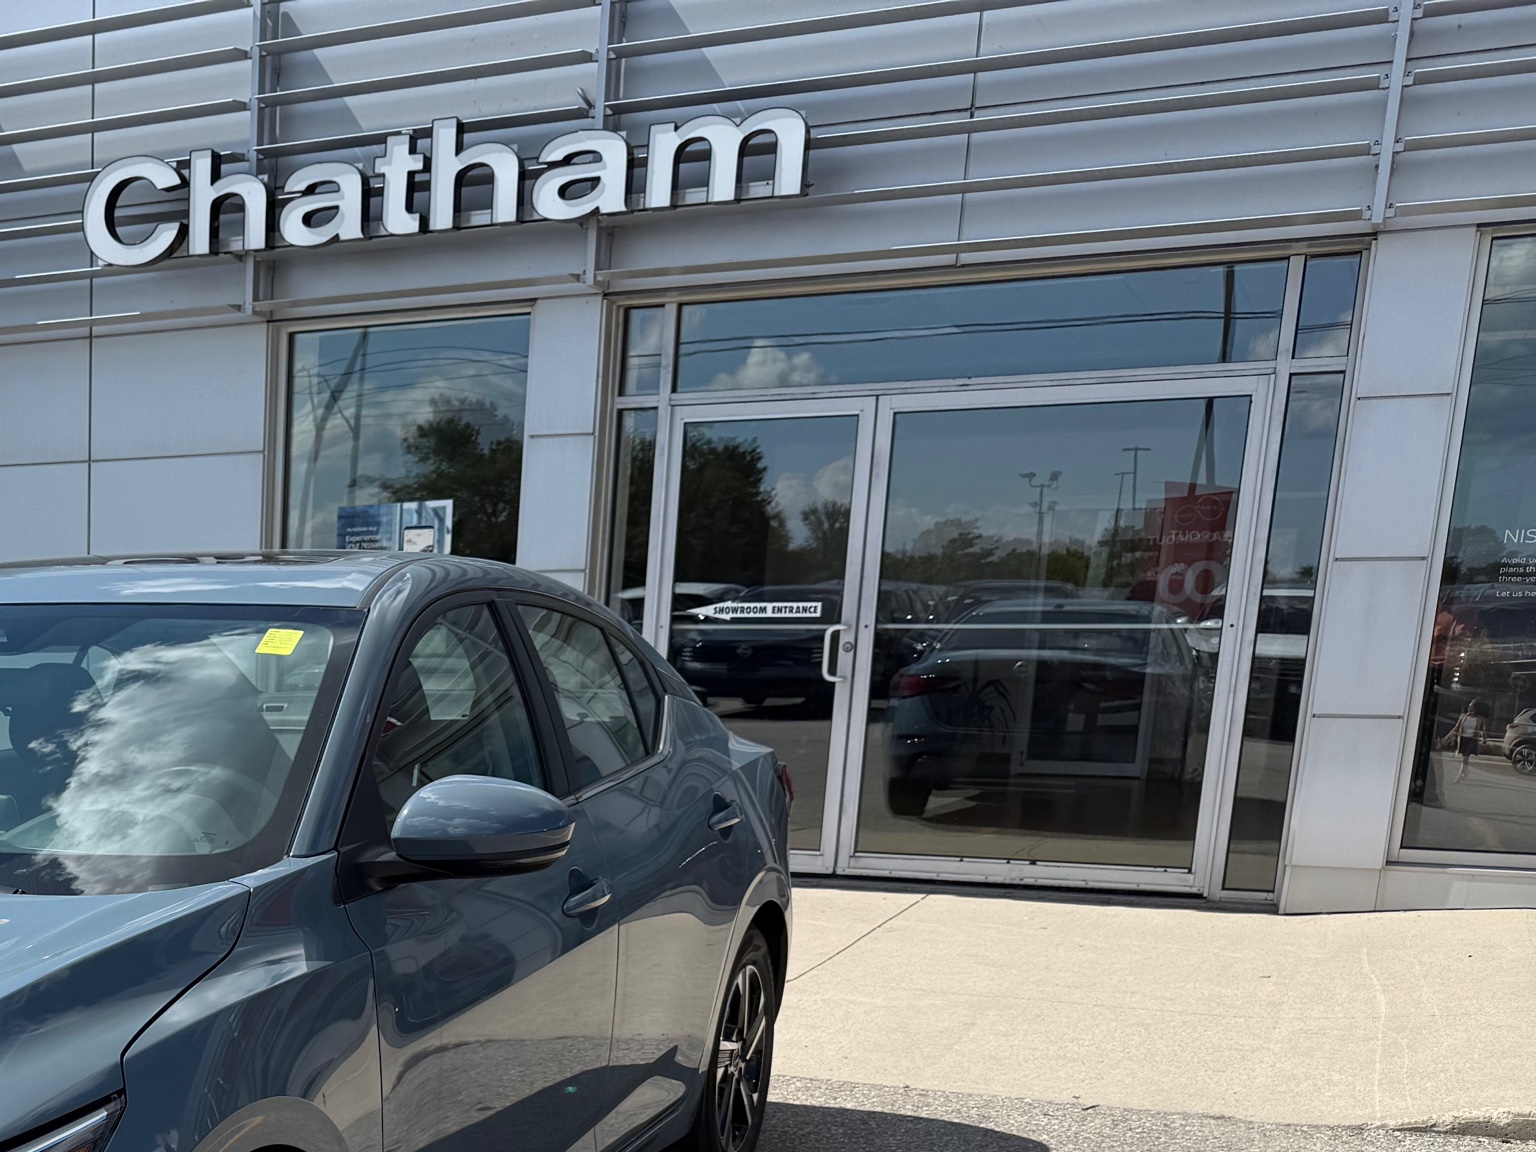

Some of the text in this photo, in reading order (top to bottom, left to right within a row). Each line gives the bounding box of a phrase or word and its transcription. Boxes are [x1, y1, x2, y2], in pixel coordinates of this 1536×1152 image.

[82, 106, 809, 267] Chatham
[1501, 556, 1526, 564] Avoid
[1499, 566, 1525, 574] plans
[1496, 590, 1510, 598] Let
[712, 604, 819, 616] SHOWROOM ENTRANCE
